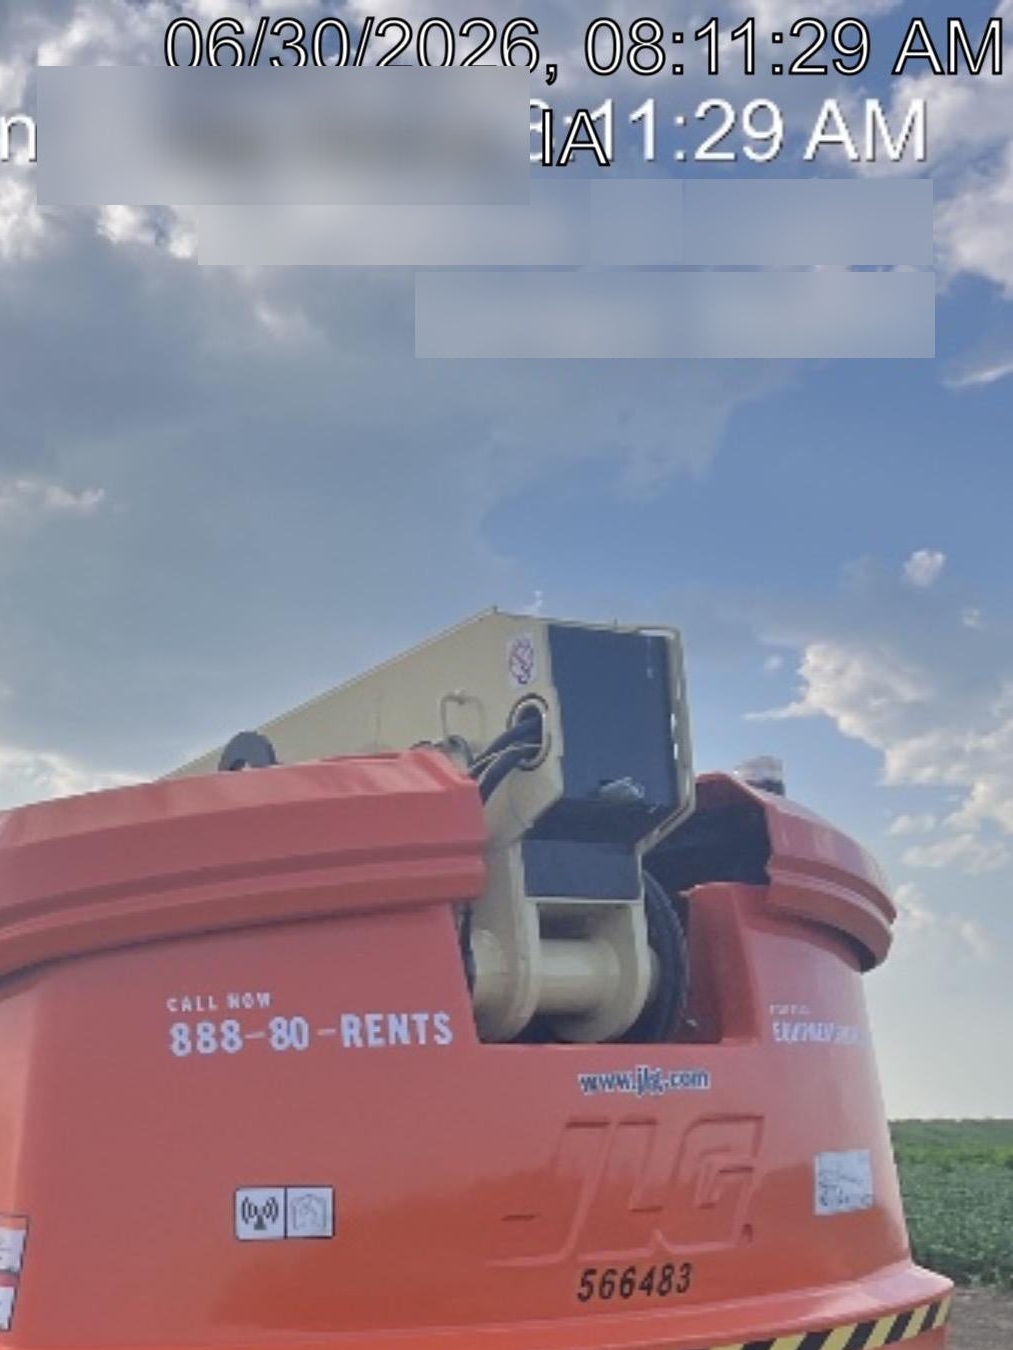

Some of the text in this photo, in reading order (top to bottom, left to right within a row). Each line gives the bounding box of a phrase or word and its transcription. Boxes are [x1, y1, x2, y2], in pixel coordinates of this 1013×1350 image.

[166, 992, 271, 1013] CALL NOW
[576, 1262, 694, 1302] 566483
